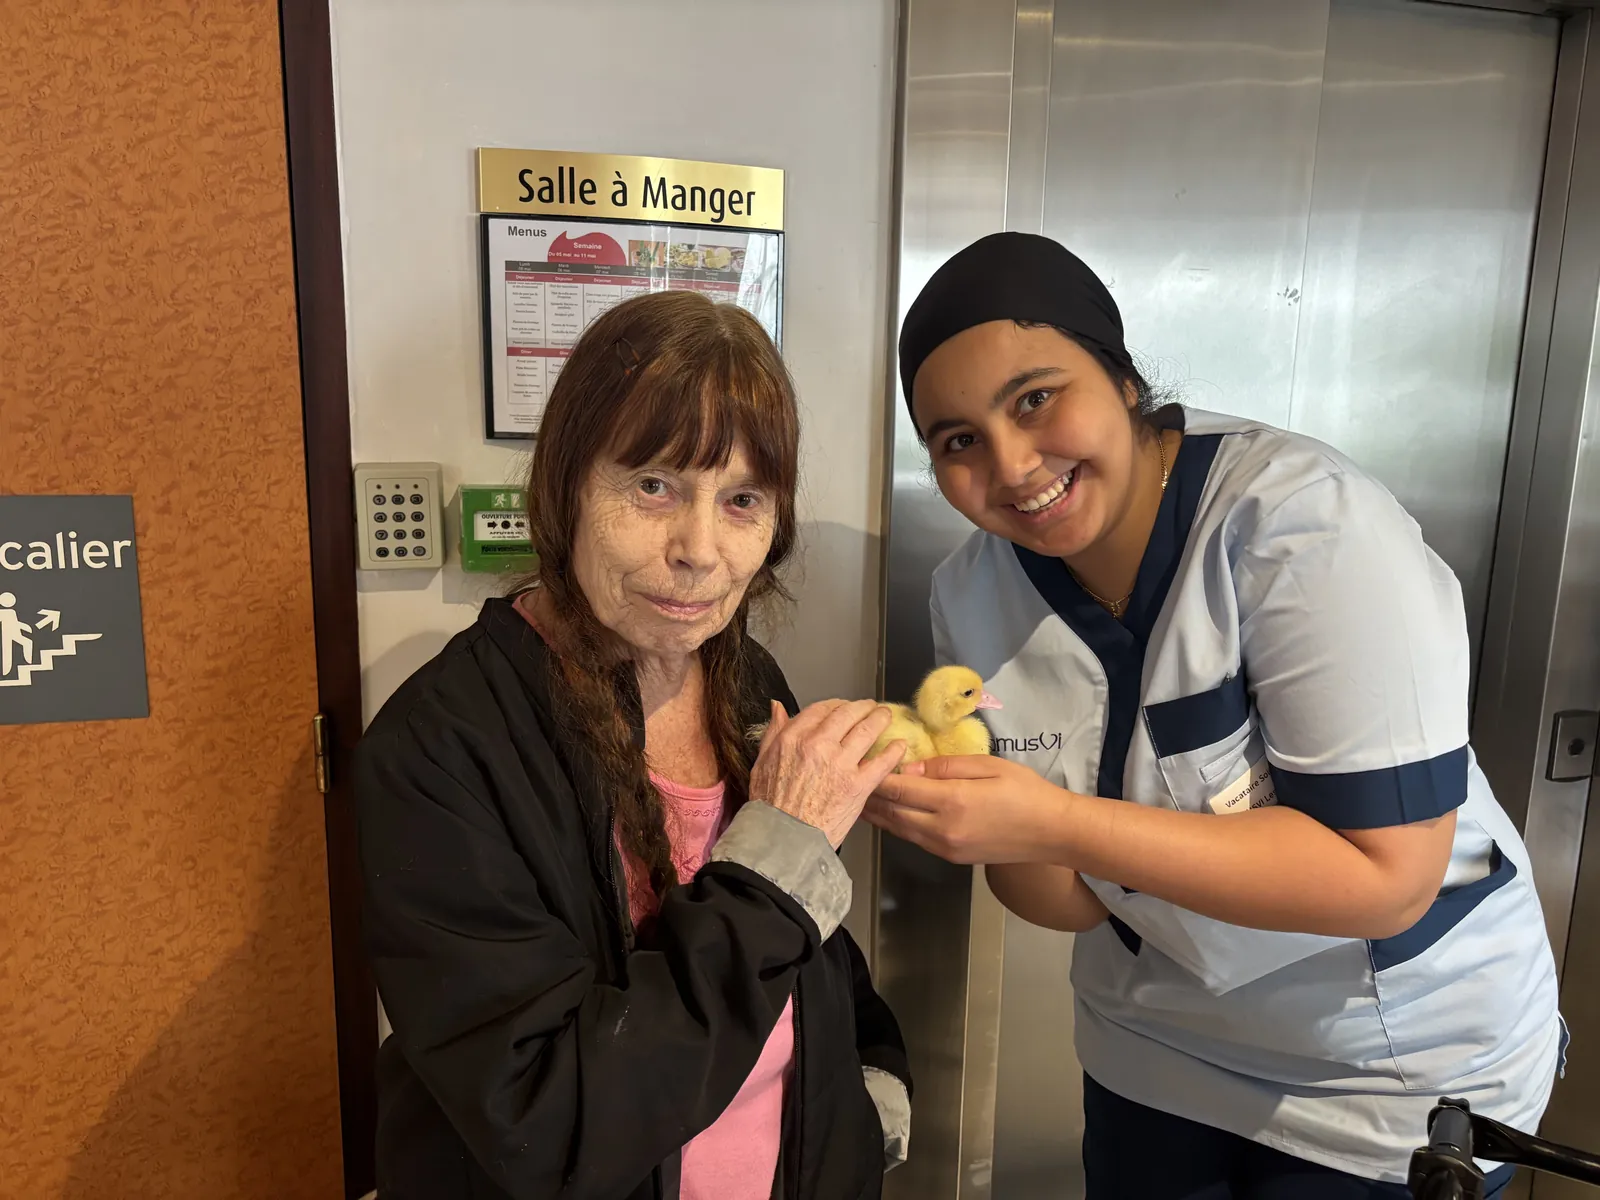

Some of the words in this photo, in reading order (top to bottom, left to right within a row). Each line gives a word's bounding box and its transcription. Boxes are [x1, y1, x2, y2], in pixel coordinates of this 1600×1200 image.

[518, 166, 597, 206] Salle
[611, 171, 628, 207] à
[642, 176, 756, 223] Manger
[508, 226, 547, 238] Menus
[0, 531, 131, 571] calier
[1225, 782, 1260, 808] Vacataire
